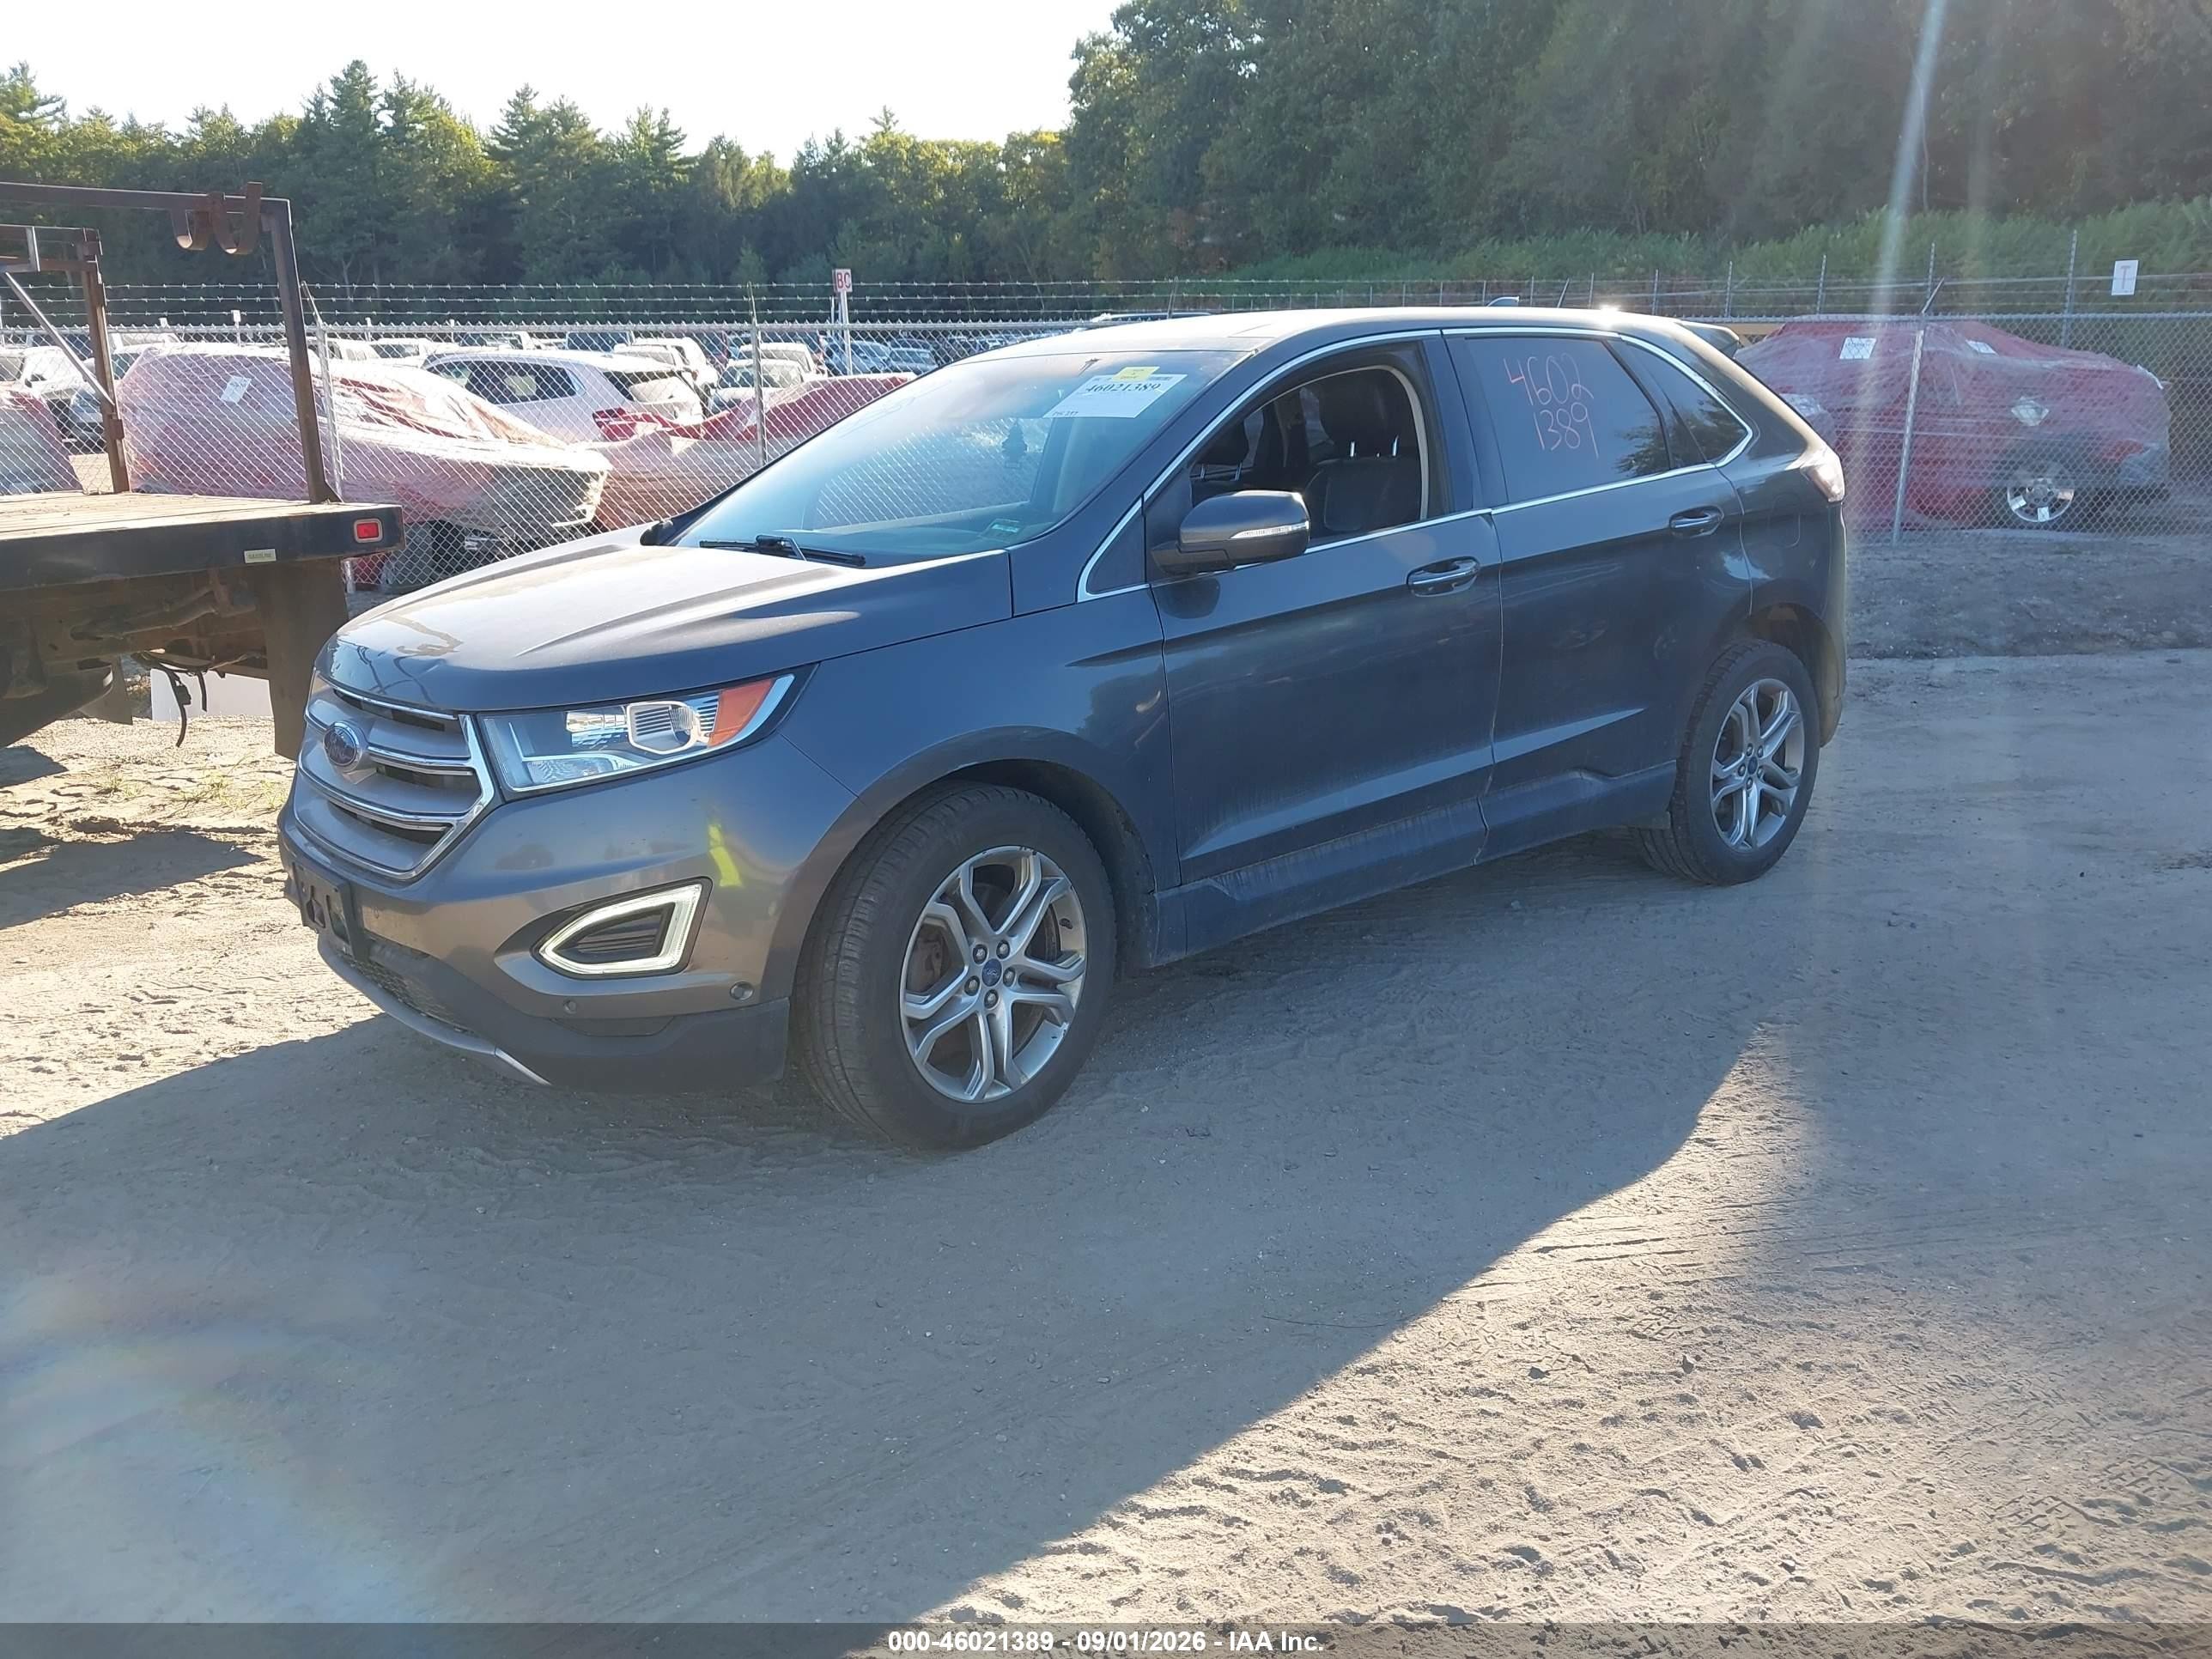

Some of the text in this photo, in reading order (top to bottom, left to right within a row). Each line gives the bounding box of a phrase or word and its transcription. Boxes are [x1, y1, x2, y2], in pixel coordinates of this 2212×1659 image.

[836, 272, 851, 289] BC
[1085, 383, 1161, 392] 46021389
[1503, 353, 1595, 406] 4602
[1533, 402, 1599, 458] 1389
